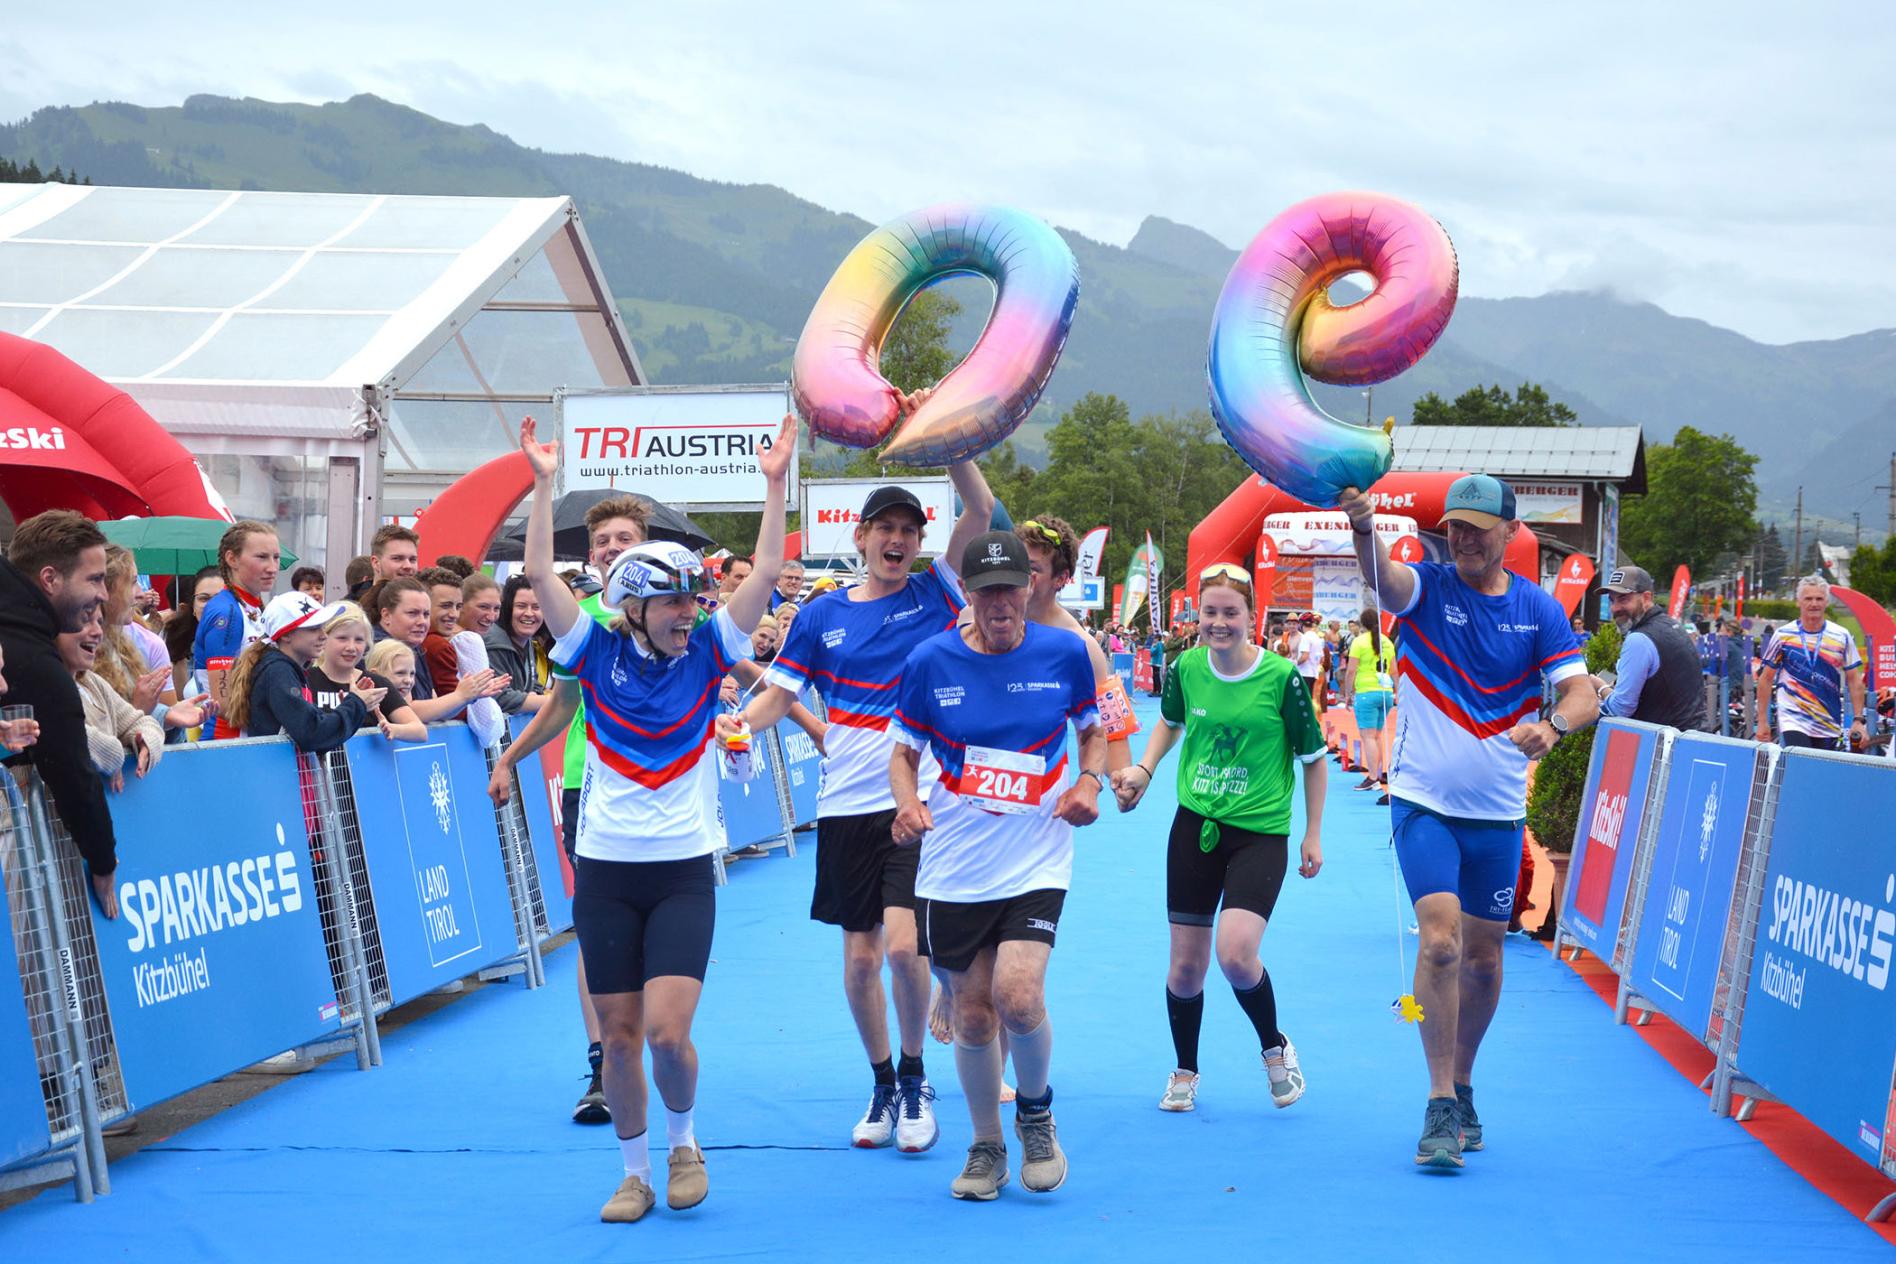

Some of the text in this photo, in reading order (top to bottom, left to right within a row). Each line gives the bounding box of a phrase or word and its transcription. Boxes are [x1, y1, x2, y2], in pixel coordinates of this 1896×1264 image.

[0, 427, 66, 450] zSki
[574, 427, 774, 460] TRI AUSTRIA
[580, 462, 762, 478] www.triathlon-austria.
[817, 506, 937, 525] KitzL
[623, 563, 644, 586] 204
[317, 690, 349, 710] PU
[976, 769, 1028, 801] 204
[119, 855, 281, 953] SPARKASSE
[418, 864, 449, 904] LAND
[343, 883, 358, 930] DAMMANN
[425, 903, 460, 944] TIROL
[1667, 884, 1690, 926] LAND
[1660, 926, 1681, 970] TIROL
[1768, 874, 1874, 982] SPARKASSE
[60, 949, 78, 1010] DAMMANN
[132, 946, 210, 1009] Kitzbühel
[1760, 950, 1807, 1010] Kitzbühel
